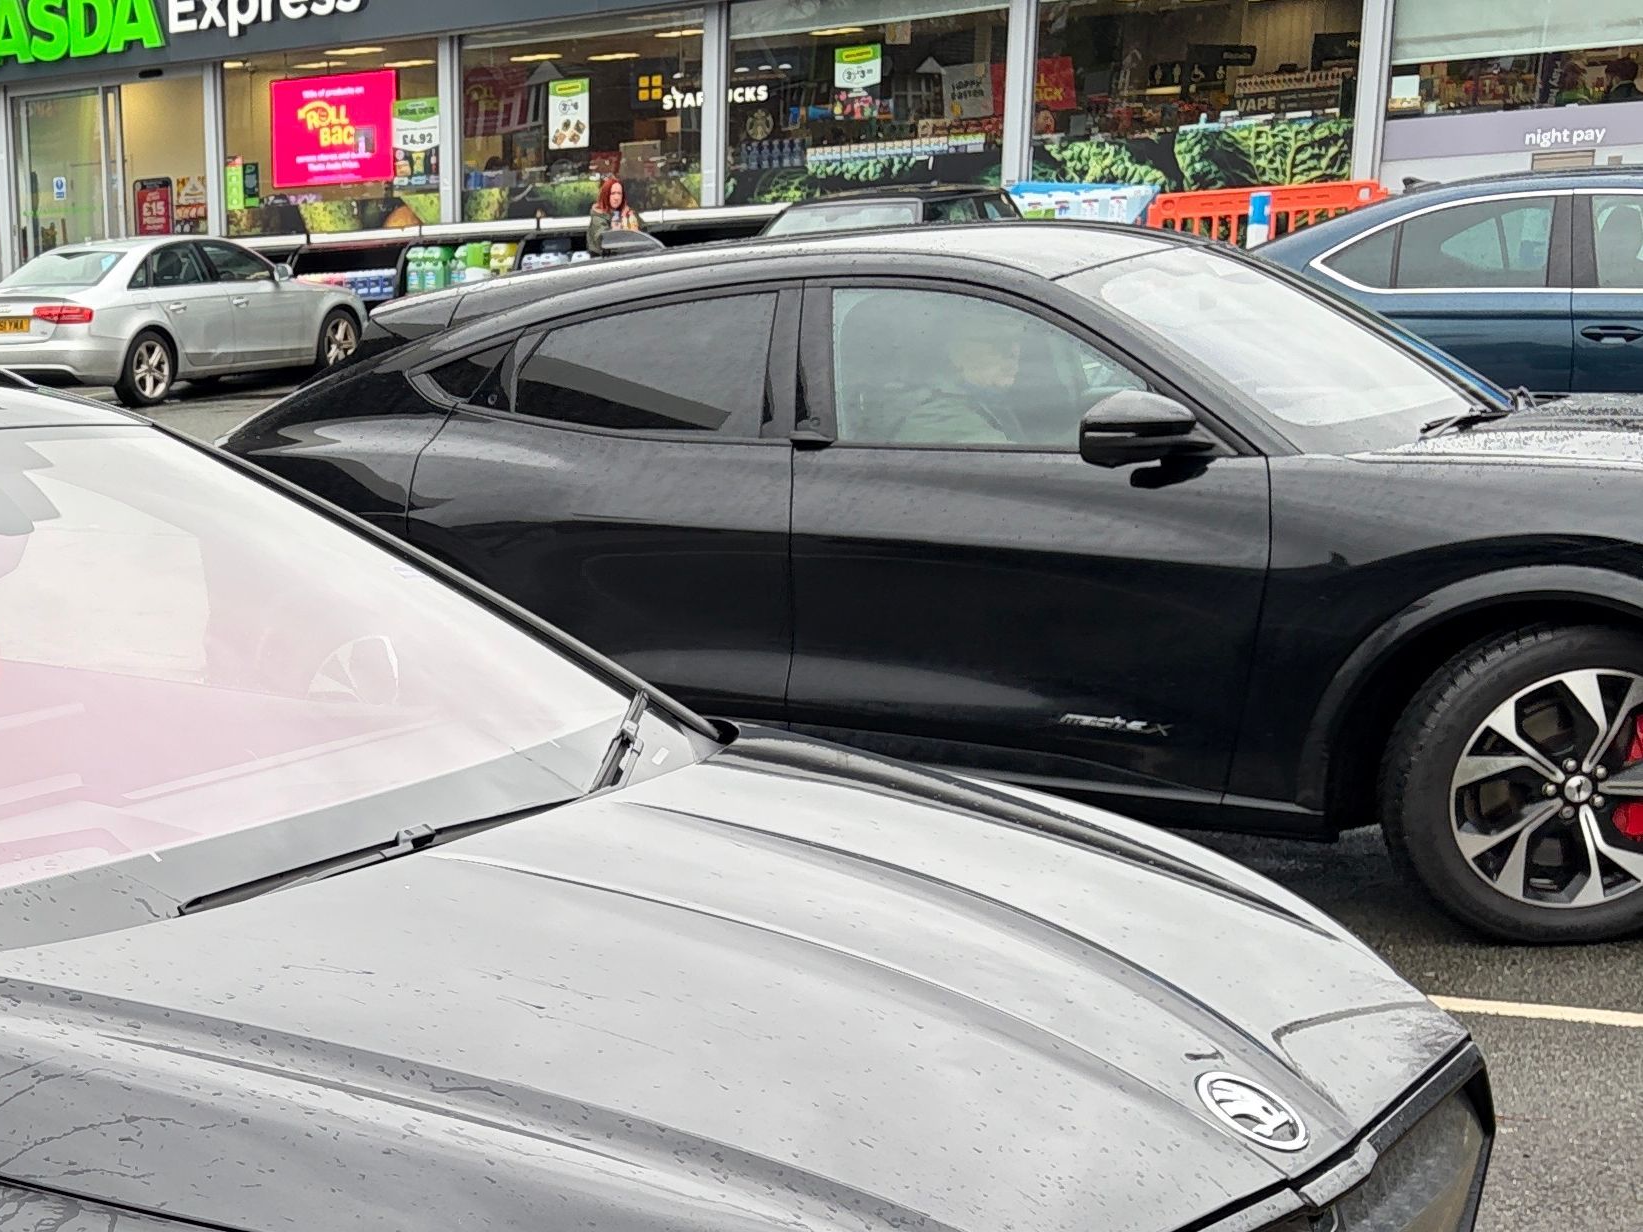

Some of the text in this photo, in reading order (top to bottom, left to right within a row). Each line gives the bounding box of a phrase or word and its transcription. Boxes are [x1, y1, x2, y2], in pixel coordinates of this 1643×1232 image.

[1236, 96, 1276, 113] VAPE
[304, 104, 350, 131] ROLL
[1524, 127, 1607, 148] night pay
